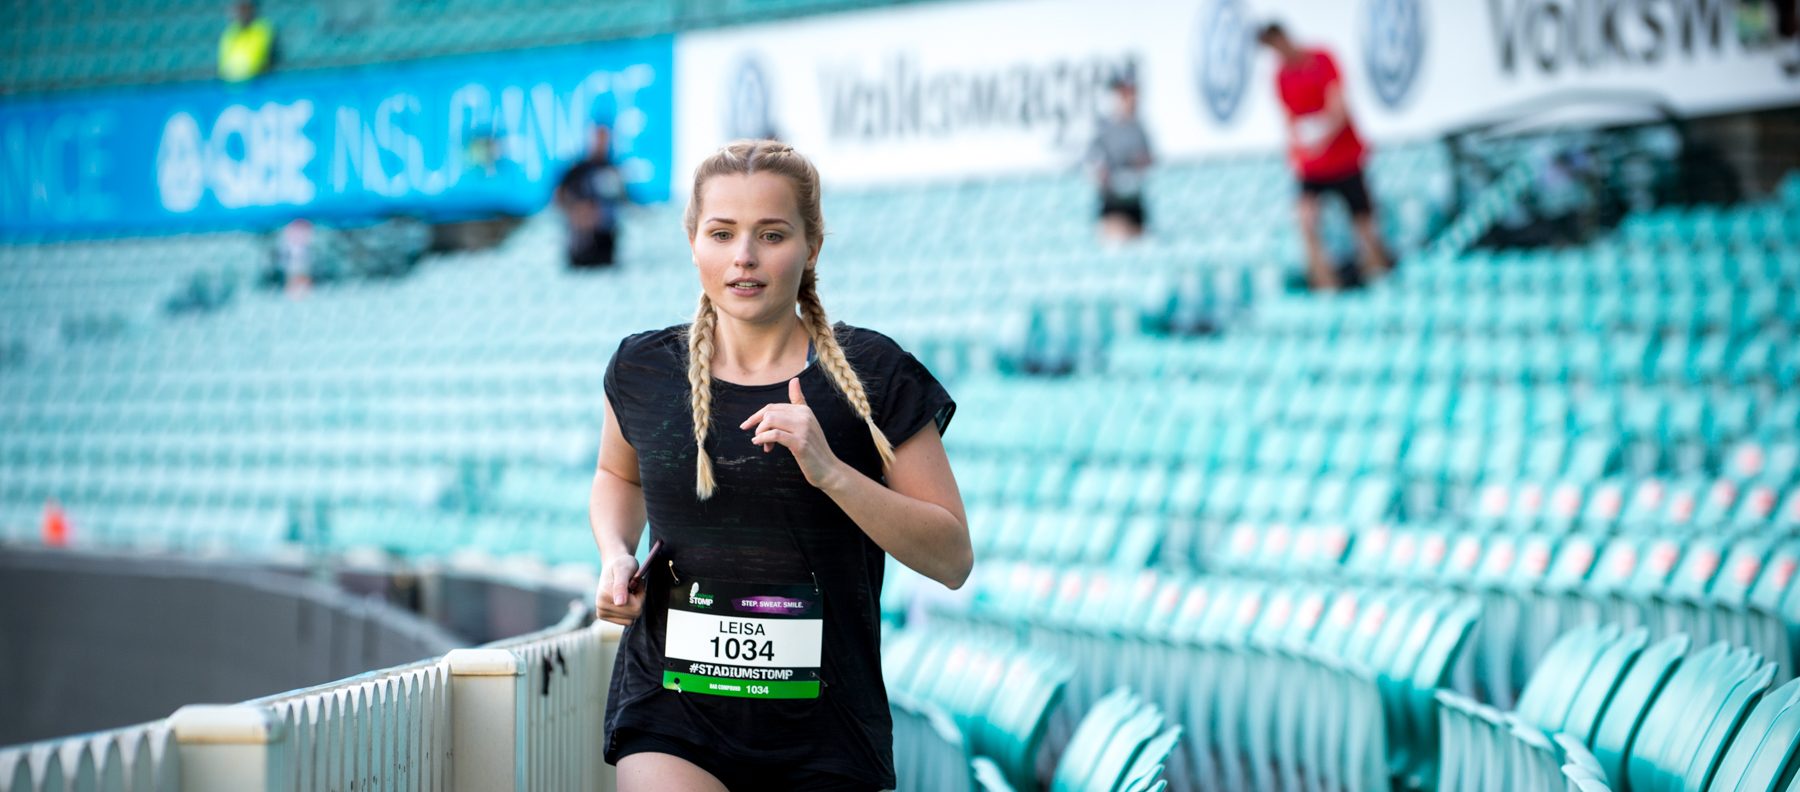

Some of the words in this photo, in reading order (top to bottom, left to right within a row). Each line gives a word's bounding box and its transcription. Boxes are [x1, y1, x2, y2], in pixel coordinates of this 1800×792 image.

[1484, 0, 1800, 78] Volksw
[326, 62, 656, 197] NSURANCE
[689, 597, 714, 606] STOMP
[741, 599, 758, 607] STEP.
[759, 600, 783, 608] SWEAT.
[719, 620, 765, 635] LEISA
[710, 636, 774, 661] 1034
[689, 663, 793, 680] #STADIUMSTOMP
[746, 685, 769, 694] 1034
